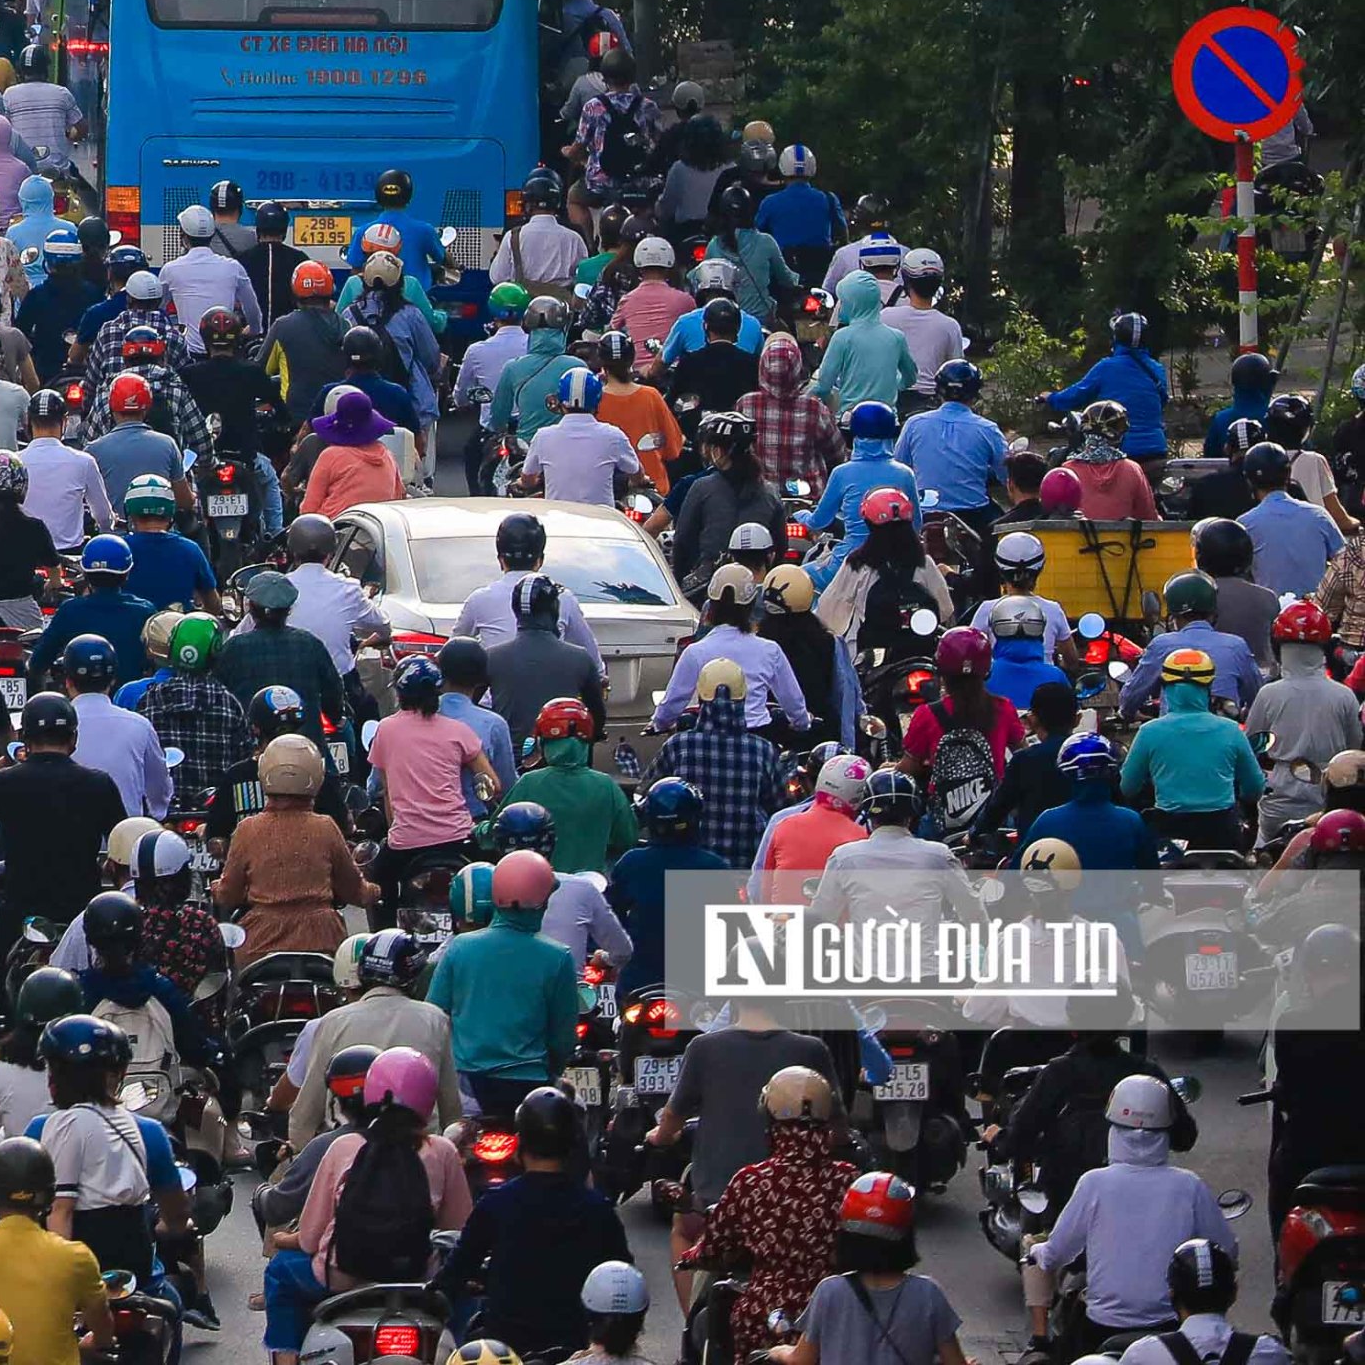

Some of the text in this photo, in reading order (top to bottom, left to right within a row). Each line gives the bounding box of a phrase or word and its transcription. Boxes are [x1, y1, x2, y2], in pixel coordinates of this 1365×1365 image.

[241, 36, 264, 51] CT
[269, 36, 292, 51] XE
[300, 231, 345, 244] 413.95
[947, 777, 986, 812] NIKE
